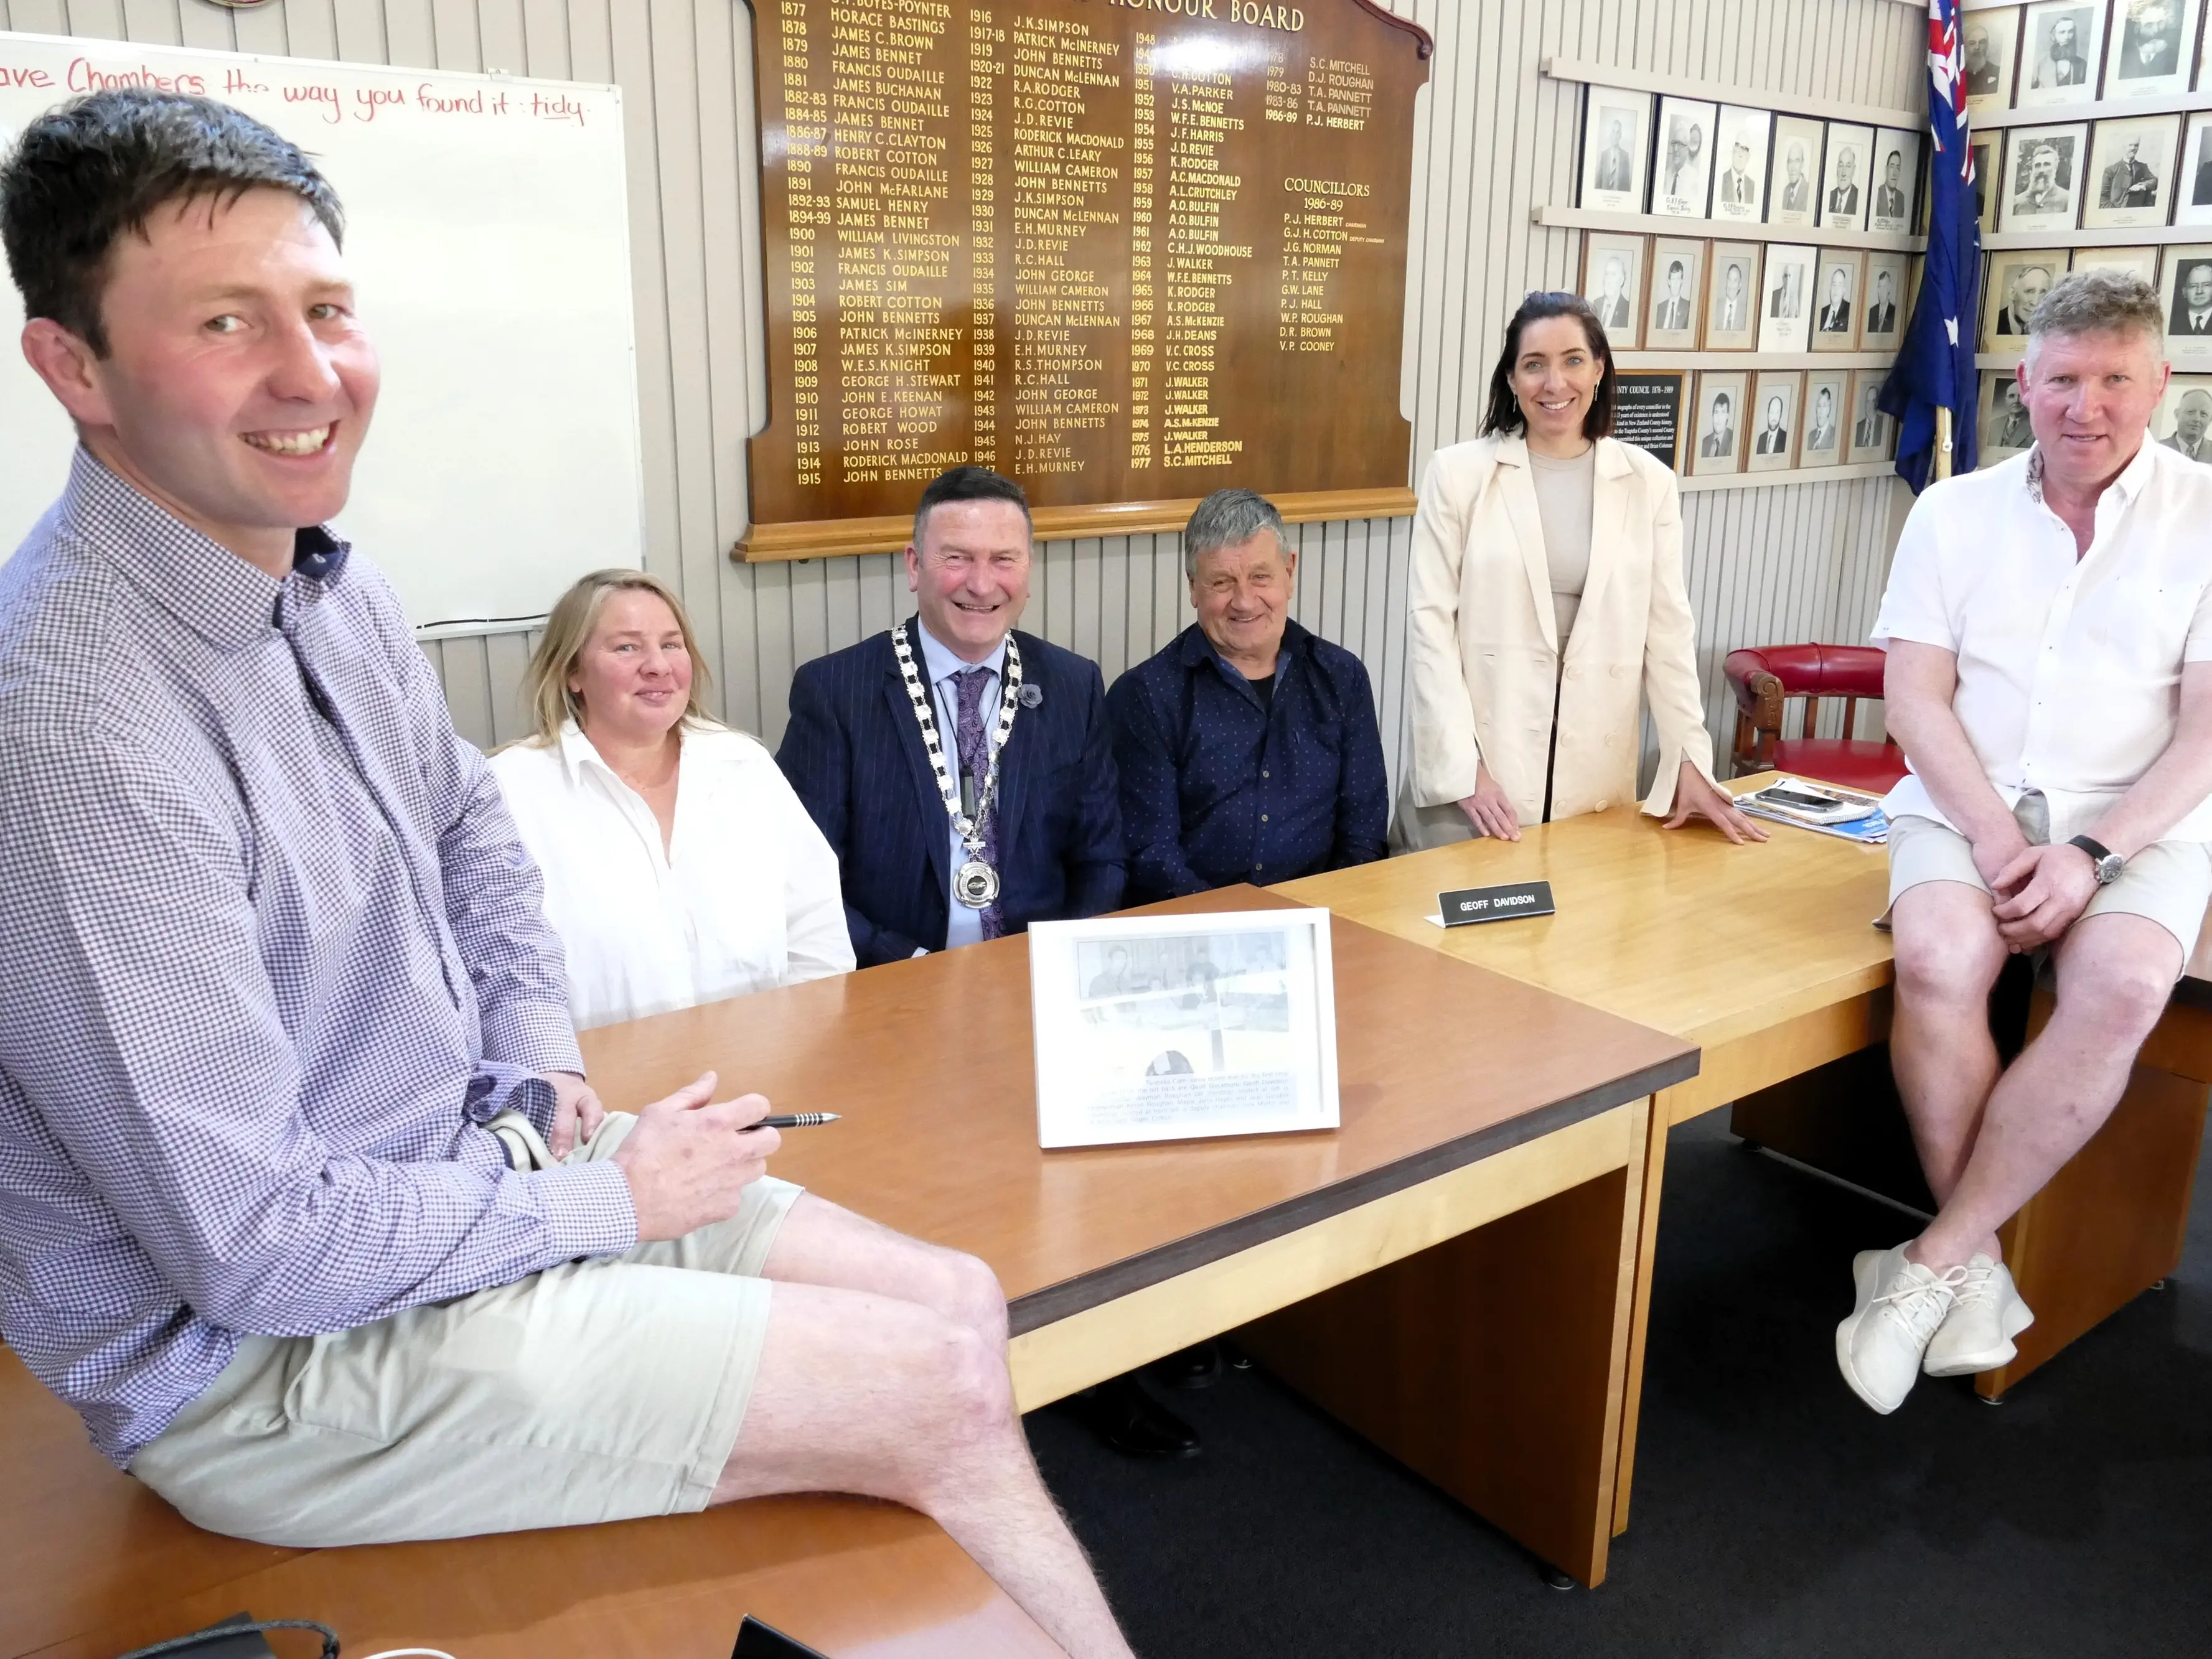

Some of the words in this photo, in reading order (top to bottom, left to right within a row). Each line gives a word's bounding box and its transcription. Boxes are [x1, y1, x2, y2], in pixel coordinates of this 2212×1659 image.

[782, 1, 806, 17] 1877
[831, 7, 883, 27] HORACE
[889, 15, 945, 34] BASTINGS
[970, 9, 991, 24] 1916
[1230, 0, 1304, 32] BOARD
[970, 26, 1005, 42] 1917-18
[1014, 31, 1056, 49] PATRICK
[1061, 37, 1120, 56] McINERNEY
[783, 37, 808, 52] 1879
[832, 43, 870, 60] JAMES
[876, 48, 922, 65] BENNET
[971, 75, 992, 89] 1922
[1135, 78, 1153, 91] 1951
[1267, 66, 1284, 77] 1979
[1329, 73, 1374, 90] ROUGHAN
[68, 57, 204, 95] Chambers
[284, 85, 342, 123] way
[354, 86, 405, 121] you
[417, 83, 482, 113] found
[1267, 80, 1301, 95] 1980-83
[1328, 88, 1372, 103] PANNETT
[1266, 109, 1297, 123] 1986-89
[1326, 116, 1365, 131] HERBERT
[972, 124, 993, 138] 1925
[1015, 128, 1062, 143] RODERICK
[1067, 133, 1124, 149] MACDONALD
[787, 142, 827, 158] 1888-89
[835, 146, 880, 161] ROBERT
[886, 150, 937, 166] COTTON
[788, 177, 811, 190] 1891
[836, 179, 872, 194] JOHN
[880, 182, 948, 199] McFARLANE
[1285, 177, 1369, 197] COUNCILLORS
[789, 194, 830, 208] 1892-93
[837, 197, 881, 211] SAMUEL
[888, 199, 928, 213] HENRY
[1133, 197, 1152, 208] 1959
[1305, 197, 1343, 212] 1986-89
[972, 205, 994, 217] 1930
[1015, 207, 1058, 220] DUNCAN
[1063, 210, 1118, 224] McLENNAN
[1305, 215, 1344, 227] HERBERT
[790, 228, 815, 240] 1900
[837, 230, 884, 243] WILLIAM
[893, 232, 959, 247] LIVINGSTON
[1133, 240, 1151, 252] 1962
[1303, 243, 1341, 255] NORMAN
[791, 261, 814, 273] 1902
[838, 263, 886, 276] FRANCIS
[893, 264, 947, 277] OUDAILLE
[973, 268, 995, 279] 1934
[1015, 269, 1045, 281] JOHN
[1051, 270, 1094, 282] GEORGE
[792, 278, 815, 290] 1903
[839, 279, 878, 291] JAMES
[886, 280, 907, 292] SIM
[1132, 284, 1153, 296] 1965
[1302, 285, 1324, 296] LANE
[1132, 314, 1151, 325] 1967
[1301, 313, 1343, 324] ROUGHAN
[794, 327, 817, 339] 1906
[840, 327, 889, 339] PATRICK
[894, 328, 963, 340] McINERNEY
[974, 344, 995, 355] 1939
[795, 360, 818, 372] 1908
[1132, 377, 1148, 388] 1971
[1629, 386, 1650, 394] COUNCIL
[796, 408, 817, 421] 1911
[843, 407, 893, 419] GEORGE
[900, 406, 942, 418] HOWAT
[975, 405, 995, 416] 1943
[1015, 403, 1061, 415] WILLIAM
[1066, 403, 1118, 414] CAMERON
[975, 436, 995, 446] 1945
[1132, 444, 1150, 456] 1976
[798, 457, 821, 470] 1914
[843, 454, 897, 467] RODERICK
[901, 452, 968, 465] MACDONALD
[1131, 457, 1151, 469] 1977
[1460, 899, 1489, 912] GEOFF
[1493, 894, 1535, 908] DAVIDSON
